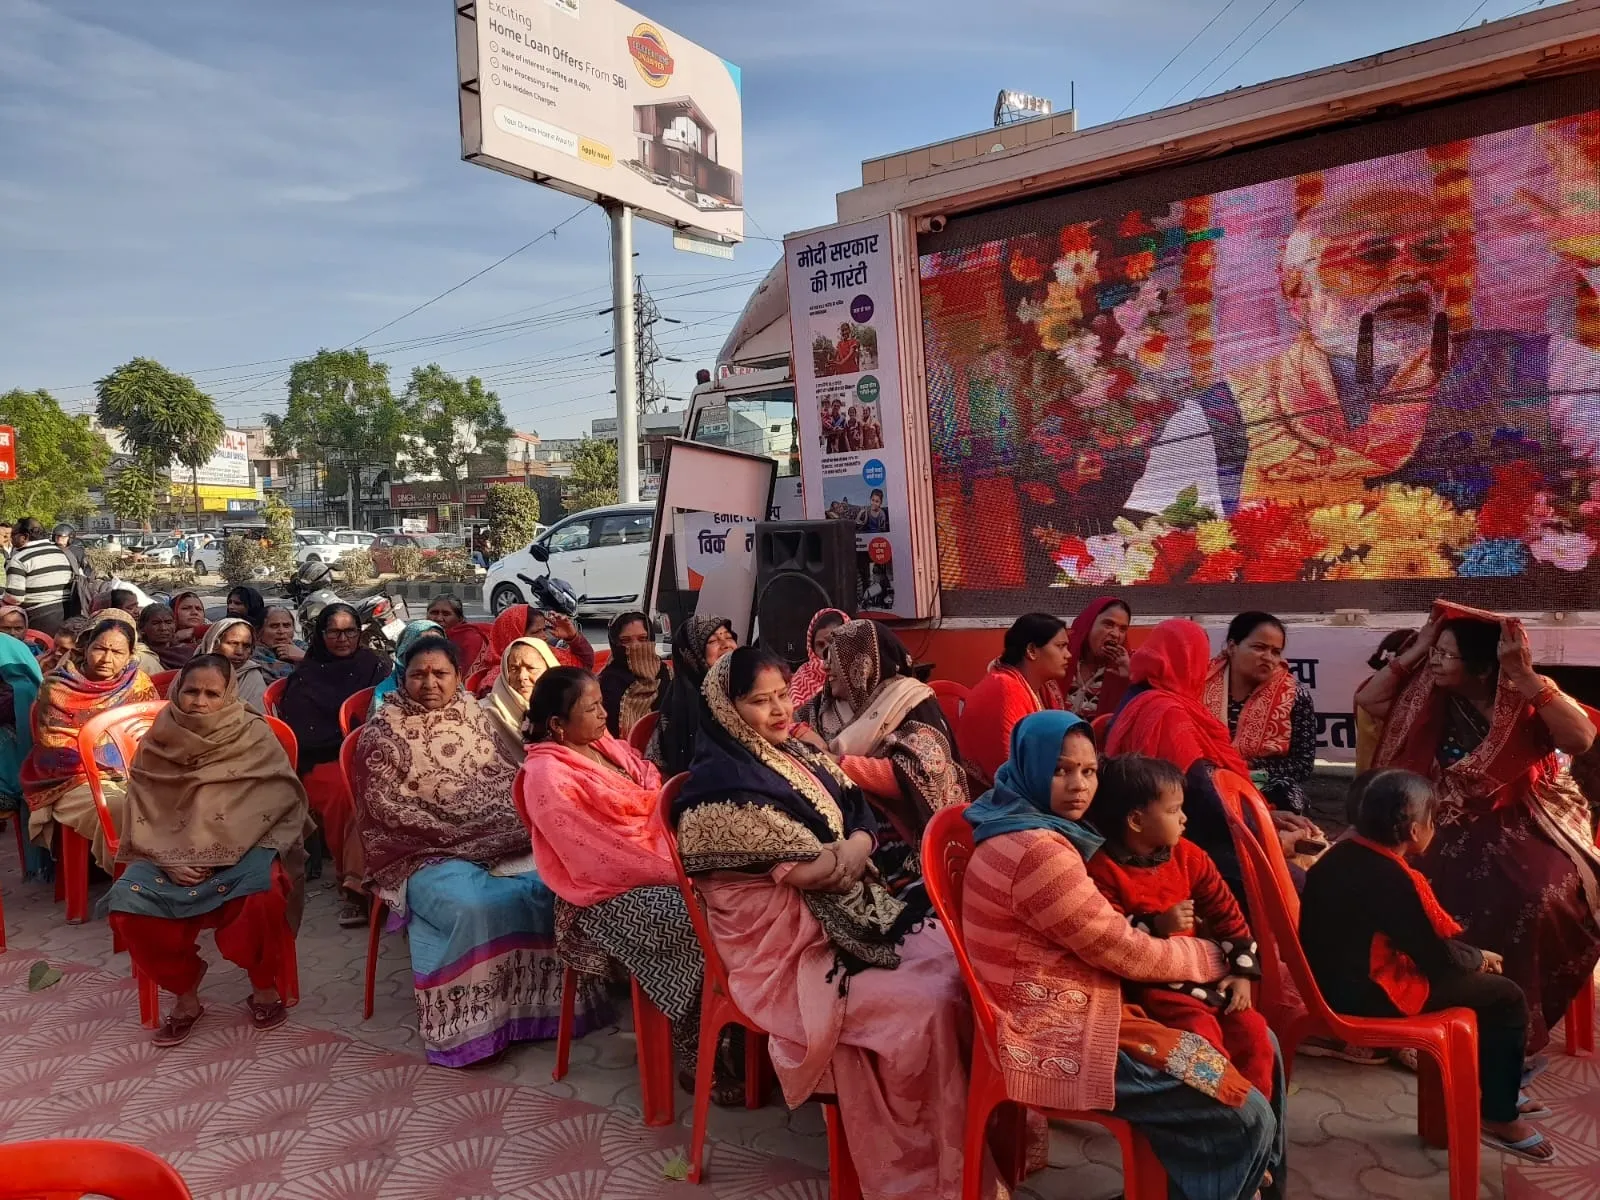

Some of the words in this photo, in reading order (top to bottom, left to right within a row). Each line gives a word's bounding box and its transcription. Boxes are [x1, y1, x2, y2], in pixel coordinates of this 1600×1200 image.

[488, 0, 532, 31] Exciting
[489, 18, 522, 44] Home
[524, 33, 550, 56] Loan
[552, 46, 584, 72] Offers
[585, 62, 610, 83] From
[612, 73, 628, 90] SBI
[514, 68, 546, 90] Processing
[534, 92, 557, 107] Charges
[797, 241, 827, 268] मोदी
[829, 234, 880, 262] सरकार
[810, 270, 828, 294] की
[830, 261, 868, 290] गारंटी
